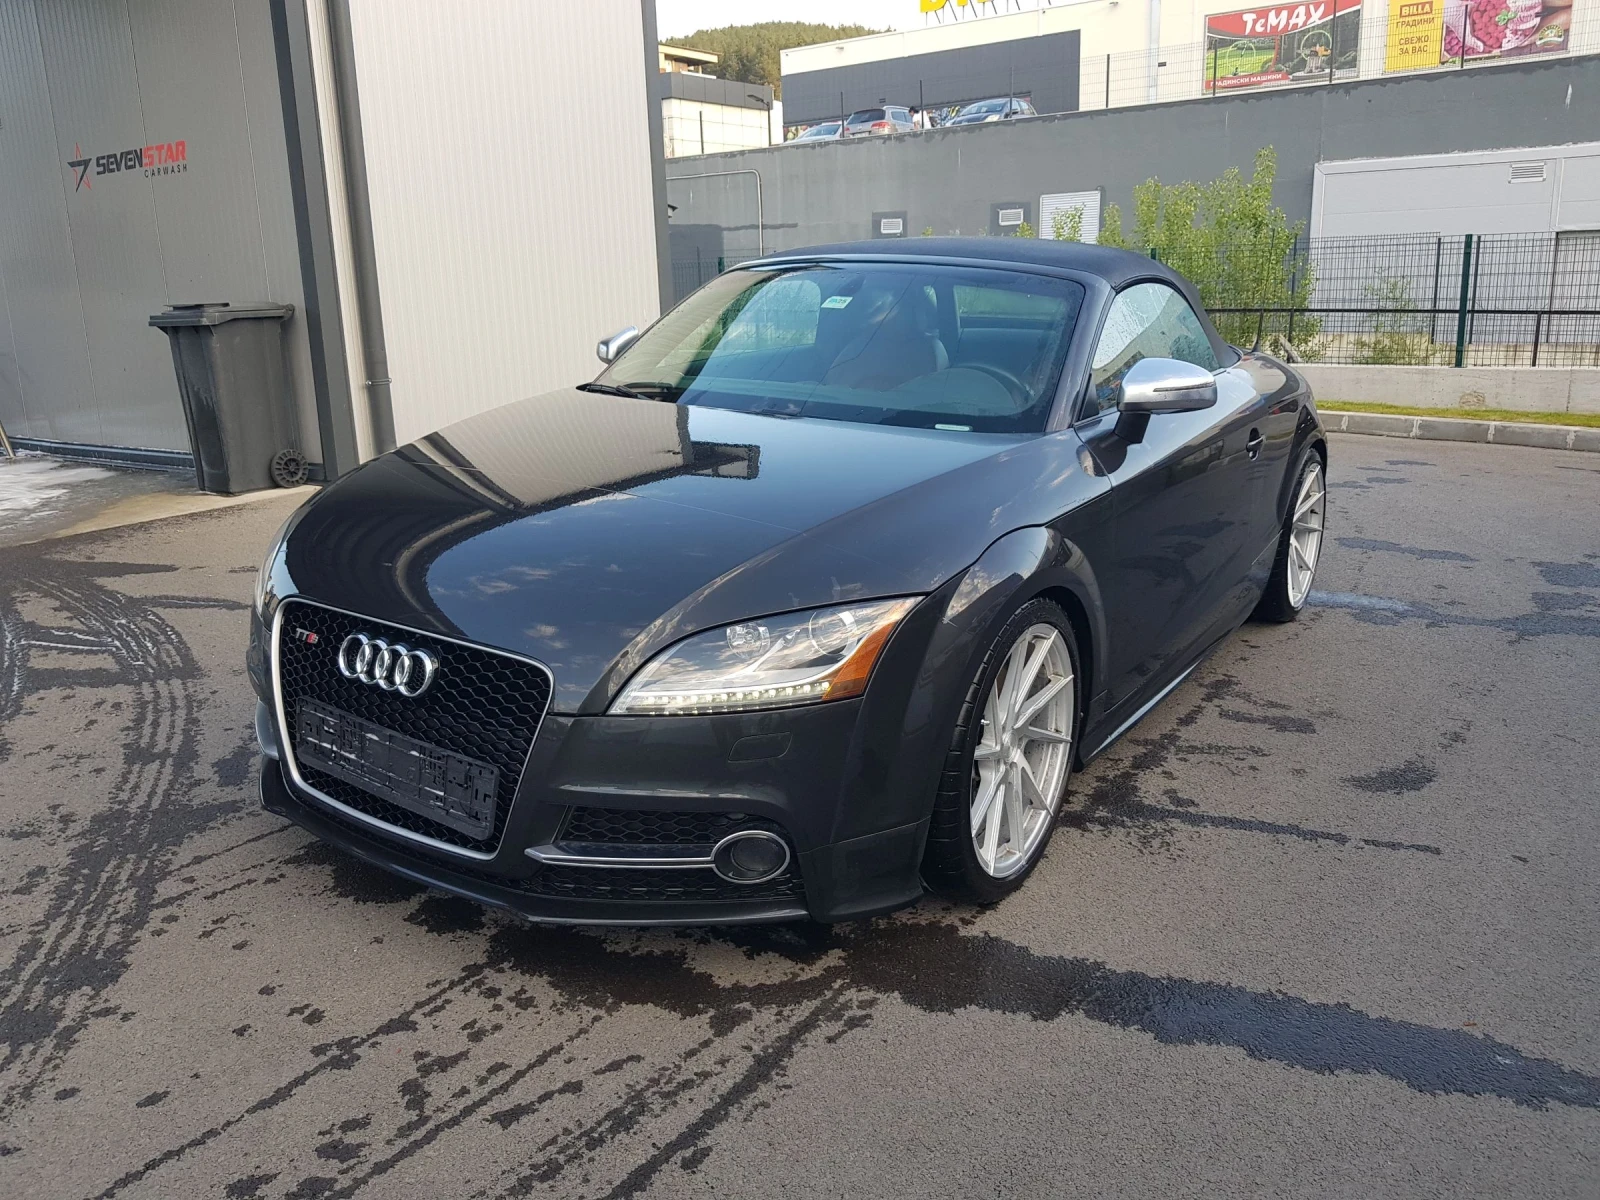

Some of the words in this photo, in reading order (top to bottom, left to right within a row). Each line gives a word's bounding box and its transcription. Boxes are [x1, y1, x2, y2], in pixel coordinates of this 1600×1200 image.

[1402, 4, 1431, 15] BILLA
[1396, 17, 1435, 28] ГРАДИНИ
[1399, 35, 1430, 46] СВЕЖО
[1399, 46, 1410, 55] ЗА
[1411, 45, 1428, 54] ВАС
[1250, 73, 1282, 83] МАШИНИ
[144, 164, 188, 178] CARWASH
